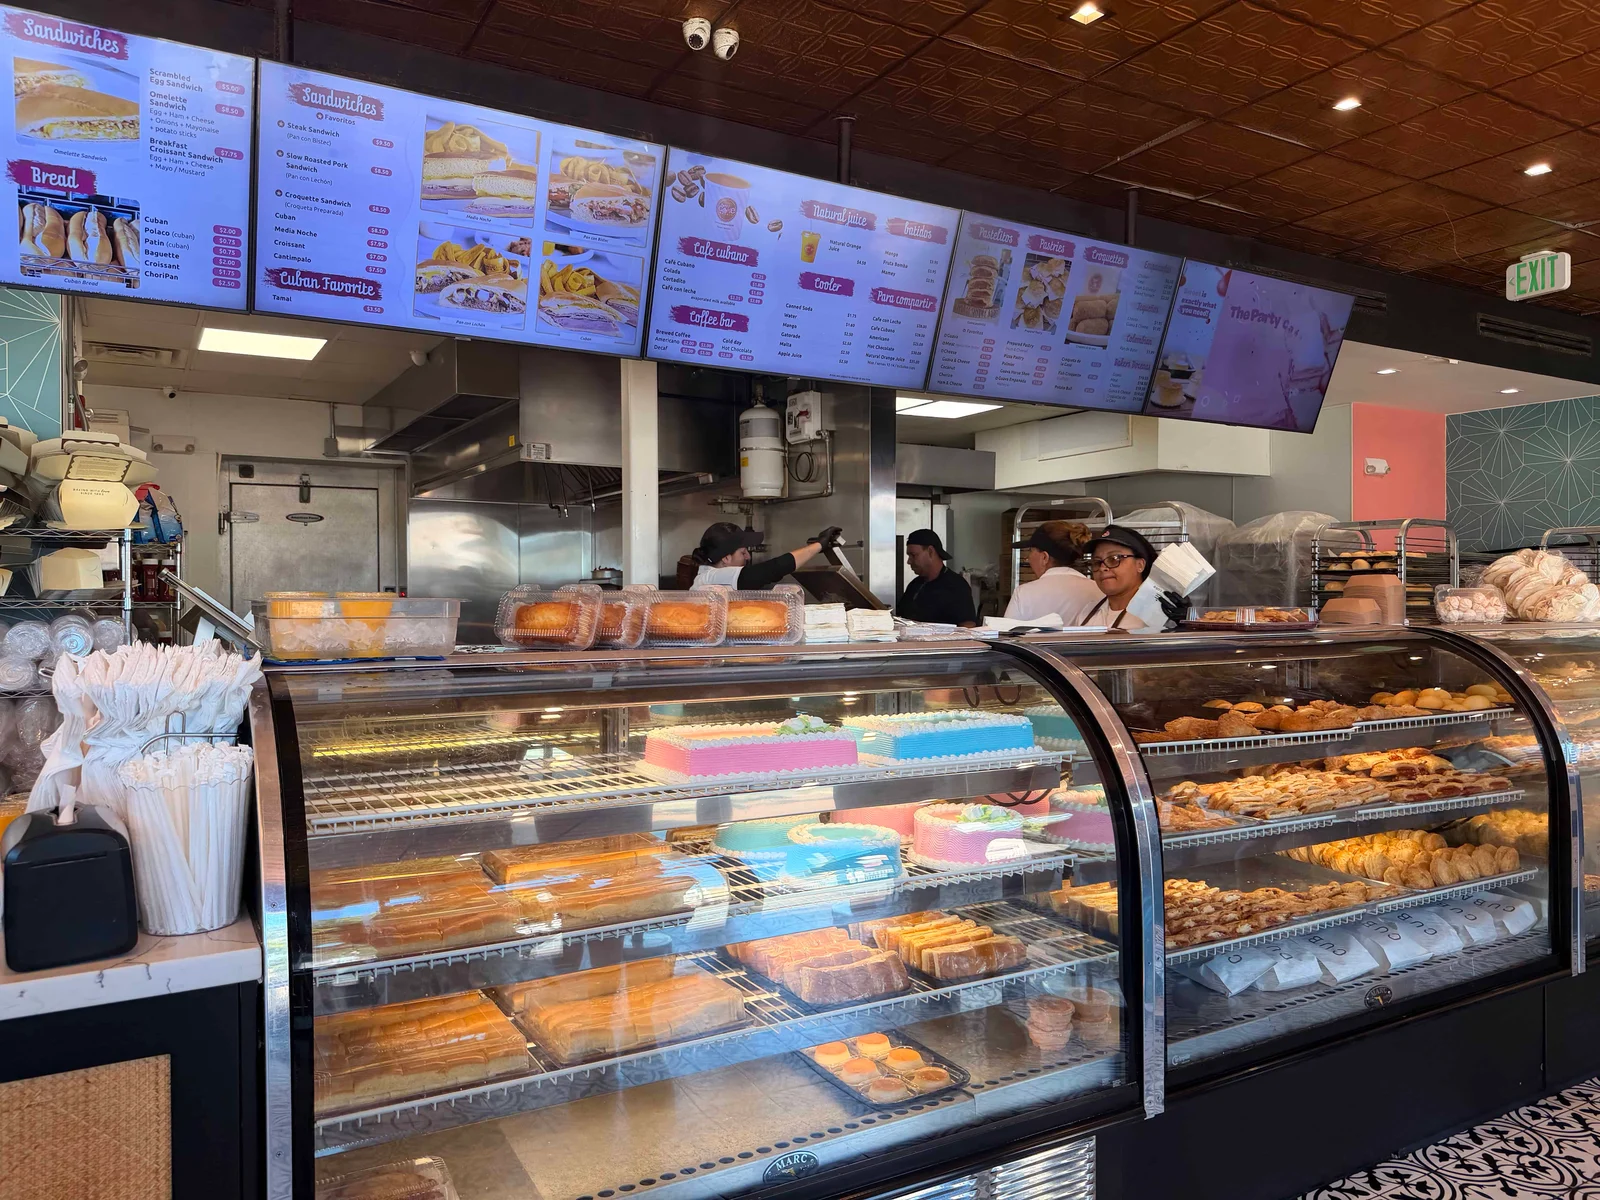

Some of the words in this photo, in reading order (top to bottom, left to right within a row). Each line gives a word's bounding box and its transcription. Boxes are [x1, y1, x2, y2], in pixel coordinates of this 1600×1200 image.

[23, 18, 119, 54] Sandwiches
[150, 68, 191, 82] Scrambled
[150, 77, 164, 86] Egg
[166, 80, 202, 92] Sandwich
[150, 91, 188, 104] Omelette
[302, 88, 376, 116] Sandwiches
[150, 99, 186, 111] Sandwich
[222, 106, 238, 114] $8.50
[150, 108, 162, 116] Egg
[192, 116, 214, 125] Cheese
[156, 118, 178, 126] Onions
[324, 114, 356, 126] Favoritos
[156, 126, 178, 135] potato
[287, 122, 307, 132] Steak
[308, 126, 340, 138] Sandwich
[150, 138, 188, 150] Breakfast
[286, 132, 300, 140] (Pan
[312, 136, 332, 146] Bistec)
[54, 148, 80, 158] Omelette
[81, 153, 108, 162] Sandwich
[150, 146, 186, 158] Croissant
[188, 152, 224, 164] Sandwich
[221, 150, 238, 158] $7.75
[286, 152, 303, 161] Slow
[304, 156, 331, 166] Roasted
[332, 160, 348, 169] Pork
[150, 154, 162, 162] Egg
[191, 162, 214, 170] Cheese
[286, 162, 318, 173] Sandwich
[30, 166, 80, 188] Bread
[156, 164, 173, 172] Mayo
[178, 168, 205, 176] Mustard
[285, 192, 320, 202] Croquette
[320, 197, 352, 208] Sandwich
[284, 202, 312, 212] (Croqueta
[314, 206, 344, 216] Preparada)
[813, 204, 846, 223] Natural
[846, 211, 868, 227] juice
[144, 216, 168, 225] Cuban
[275, 212, 296, 221] Cuban
[144, 227, 170, 236] Polaco
[172, 231, 195, 240] (cuban)
[274, 226, 296, 234] Media
[296, 228, 318, 238] Noche
[979, 227, 1014, 244] Pastelitos
[144, 238, 164, 246] Patin
[166, 242, 190, 250] (cuban)
[274, 240, 306, 249] Croissant
[830, 239, 846, 248] Natural
[846, 242, 862, 250] Orange
[1040, 238, 1065, 254] Pastries
[144, 249, 180, 259] Baguette
[274, 253, 312, 263] Cantimpalo
[694, 242, 714, 259] Cafe
[716, 246, 750, 262] cubano
[1092, 249, 1125, 265] Croquettes
[144, 260, 180, 270] Croissant
[677, 260, 696, 268] Cubano
[144, 270, 178, 280] ChoriPan
[663, 276, 686, 284] Cortadito
[1516, 254, 1558, 296] EXIT
[280, 270, 320, 290] Cuban
[322, 277, 376, 296] Favorite
[814, 277, 842, 292] Cooler
[878, 290, 895, 303] Para
[896, 296, 934, 310] compartir
[1182, 298, 1202, 307] exactly
[690, 310, 718, 328] Coffee
[720, 313, 736, 328] bar
[1230, 306, 1250, 320] The
[1250, 308, 1282, 328] Party
[654, 336, 680, 344] Americano
[776, 1154, 808, 1170] MARC
